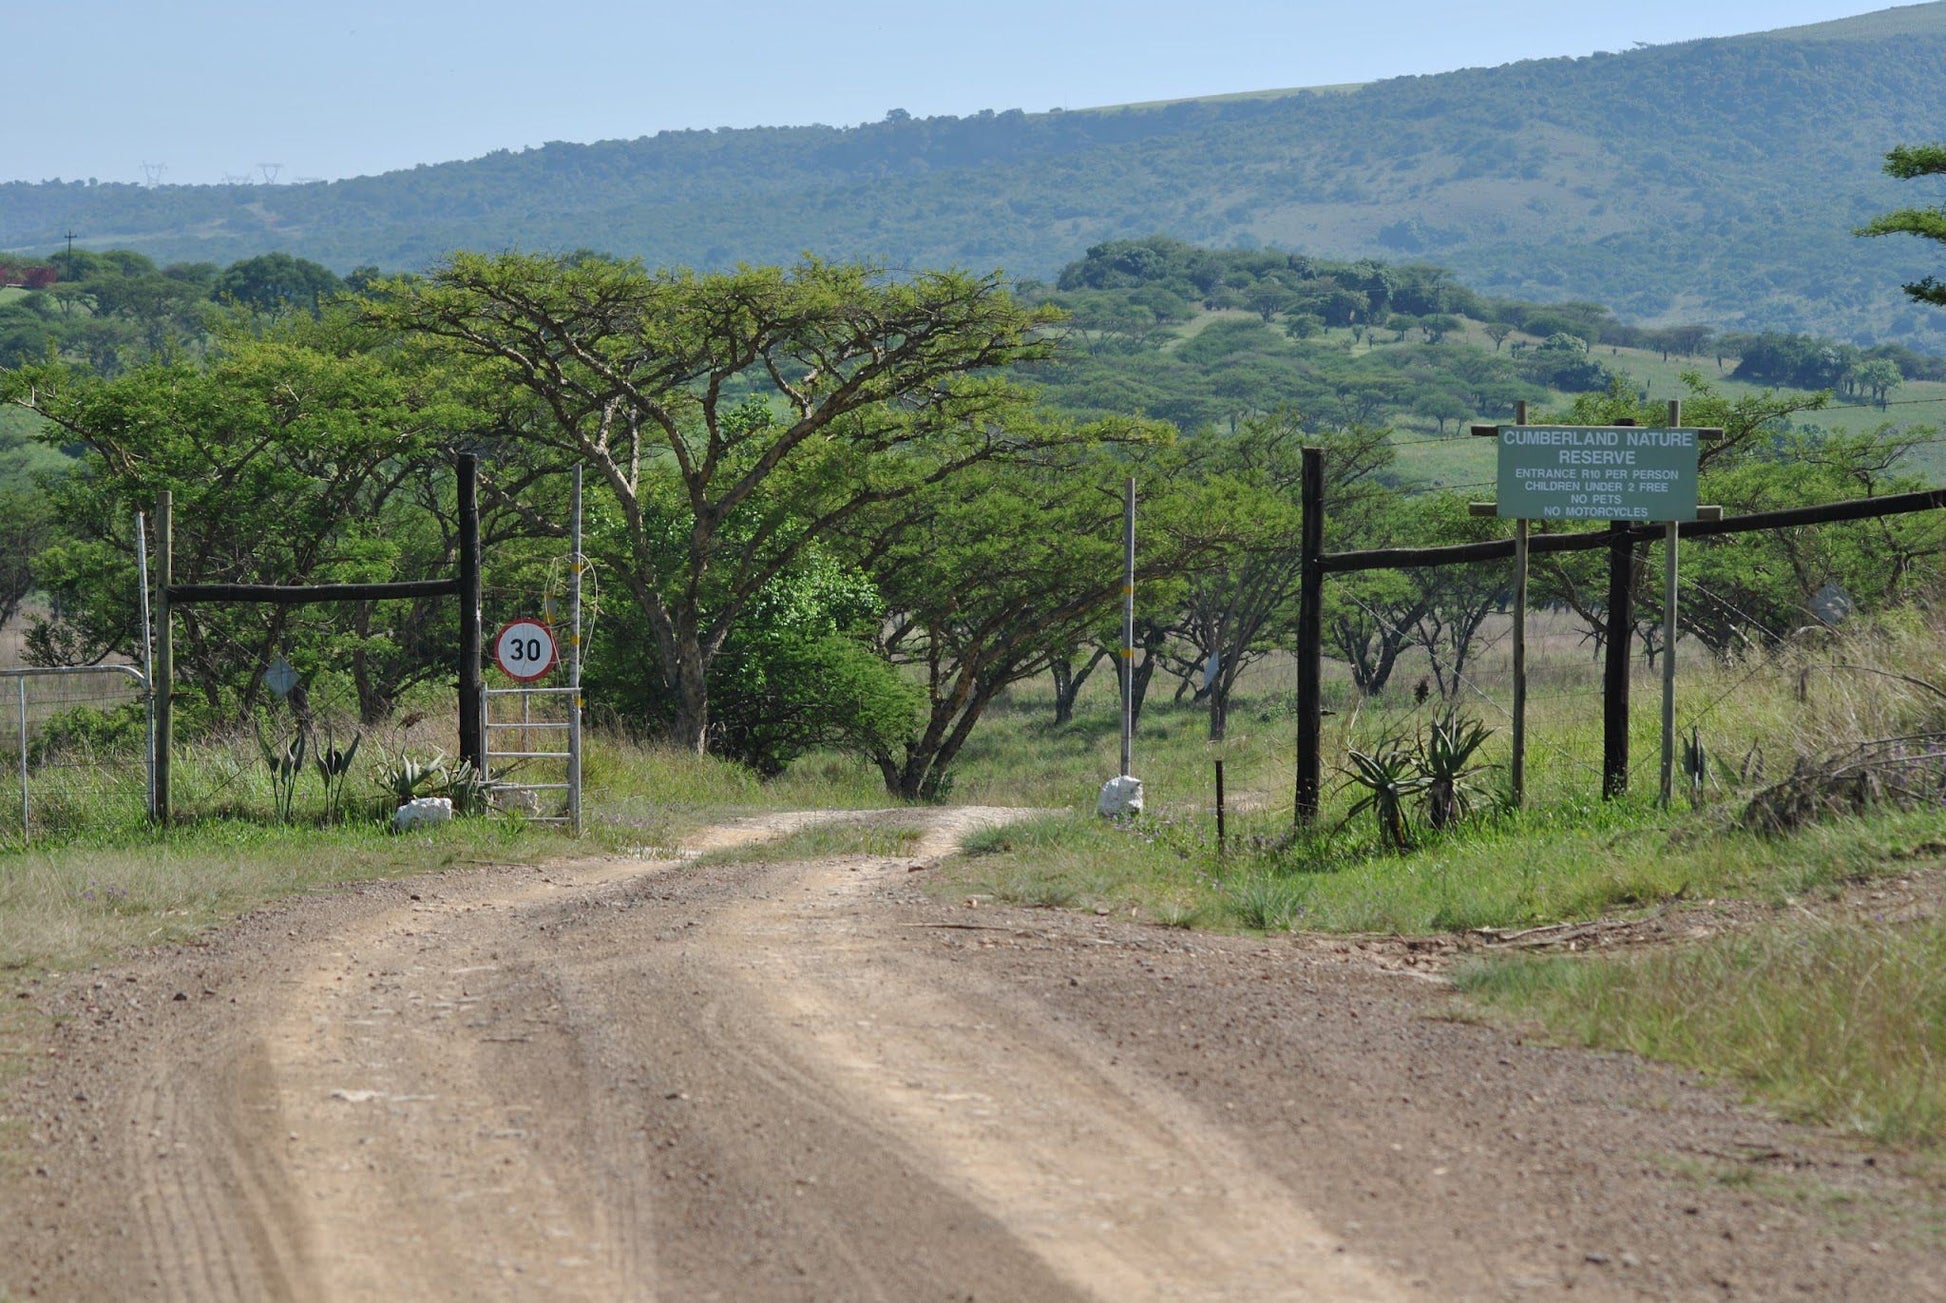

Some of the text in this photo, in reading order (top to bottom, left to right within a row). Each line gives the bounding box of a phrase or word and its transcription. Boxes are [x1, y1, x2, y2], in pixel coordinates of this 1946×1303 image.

[1503, 430, 1693, 447] CUMBERLAND NATURE
[1559, 450, 1636, 465] RESERVE
[1515, 468, 1679, 480] ENTRANCE R10 PER PERSON
[1525, 481, 1669, 492] CHILDREN UNDER 2 FREE
[1571, 494, 1622, 504] NO PETS
[1544, 506, 1648, 517] NO MOTORCYCLES
[510, 638, 541, 661] 30
